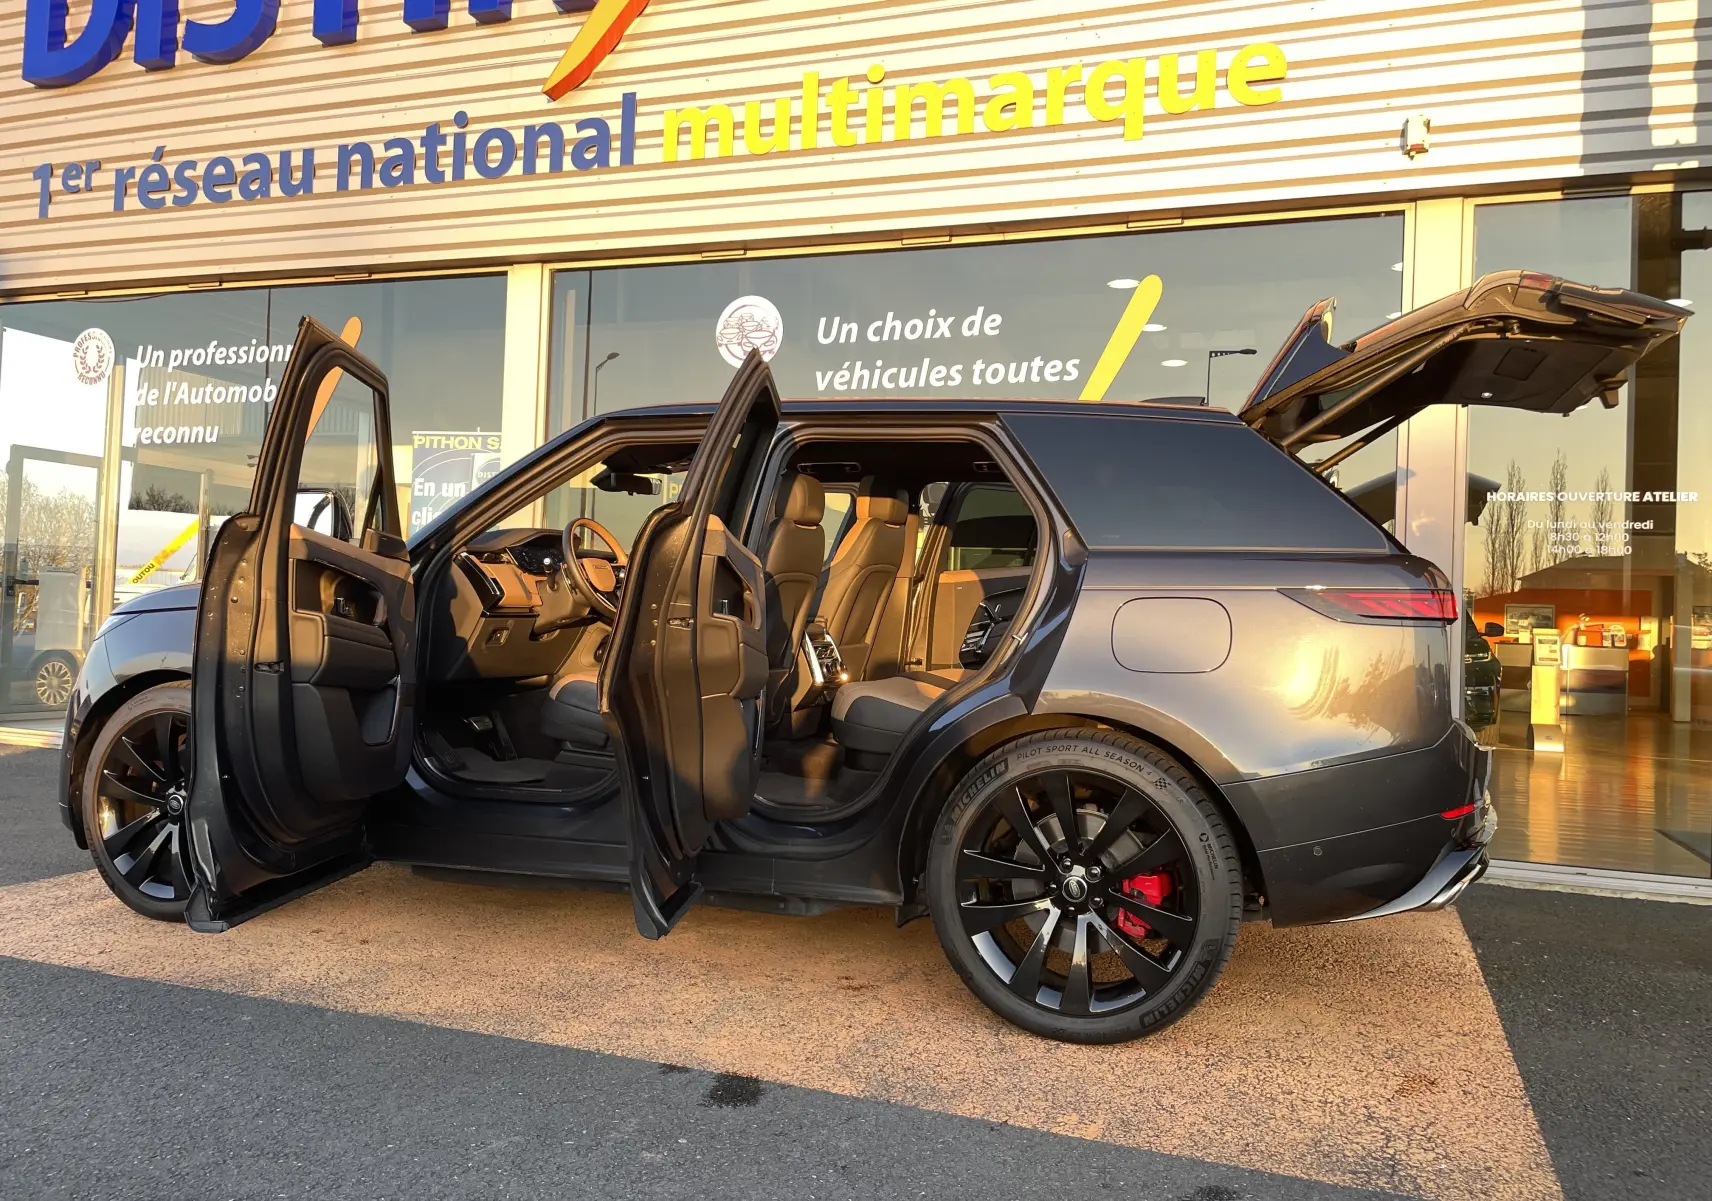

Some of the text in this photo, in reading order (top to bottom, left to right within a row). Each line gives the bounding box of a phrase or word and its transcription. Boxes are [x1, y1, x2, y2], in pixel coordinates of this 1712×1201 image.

[32, 157, 102, 219] 1er
[112, 144, 316, 212] réseau
[335, 91, 638, 192] national
[661, 40, 1288, 162] multimarque
[816, 306, 1003, 345] Un choix de
[136, 344, 165, 369] Un
[814, 356, 1081, 392] véhicules toutes
[136, 382, 160, 406] de
[133, 425, 220, 445] reconnu
[413, 435, 482, 450] PITHON
[413, 477, 466, 498] En un
[1486, 491, 1699, 502] HORAIRES OUVERTURE ATELIER
[1527, 519, 1654, 530] Du lundi au vendredi
[1549, 532, 1580, 541] 8h30
[1594, 532, 1630, 542] 12h00
[1547, 545, 1581, 554] 14h00
[1596, 545, 1632, 555] 18h00
[1016, 746, 1042, 761] PILOT
[1045, 744, 1079, 753] SPORT
[1081, 746, 1100, 756] ALL
[1103, 750, 1145, 773] SEASON
[949, 759, 1007, 823] MICHELIN
[1142, 963, 1207, 1028] MICHELIN
